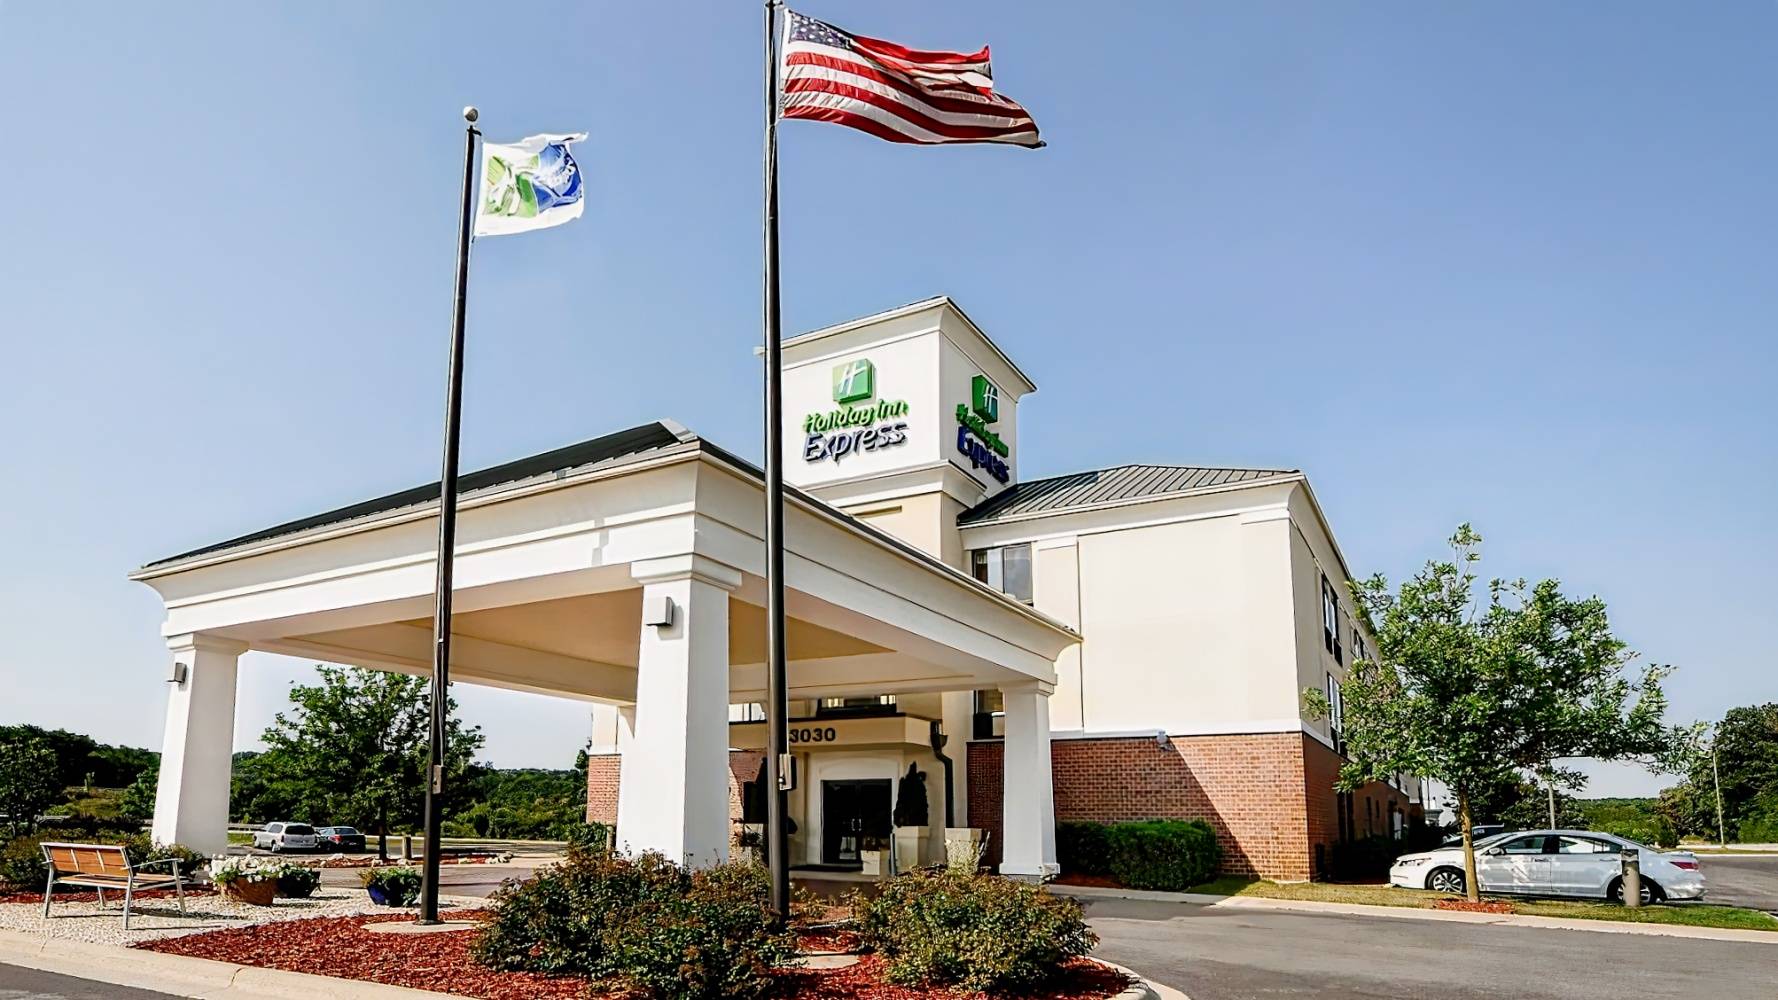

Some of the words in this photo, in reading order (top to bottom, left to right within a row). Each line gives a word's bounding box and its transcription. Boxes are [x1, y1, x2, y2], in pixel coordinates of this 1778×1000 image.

[803, 406, 875, 433] Holiday
[877, 399, 909, 421] Inn
[803, 422, 909, 465] Express
[789, 727, 836, 743] 3030
